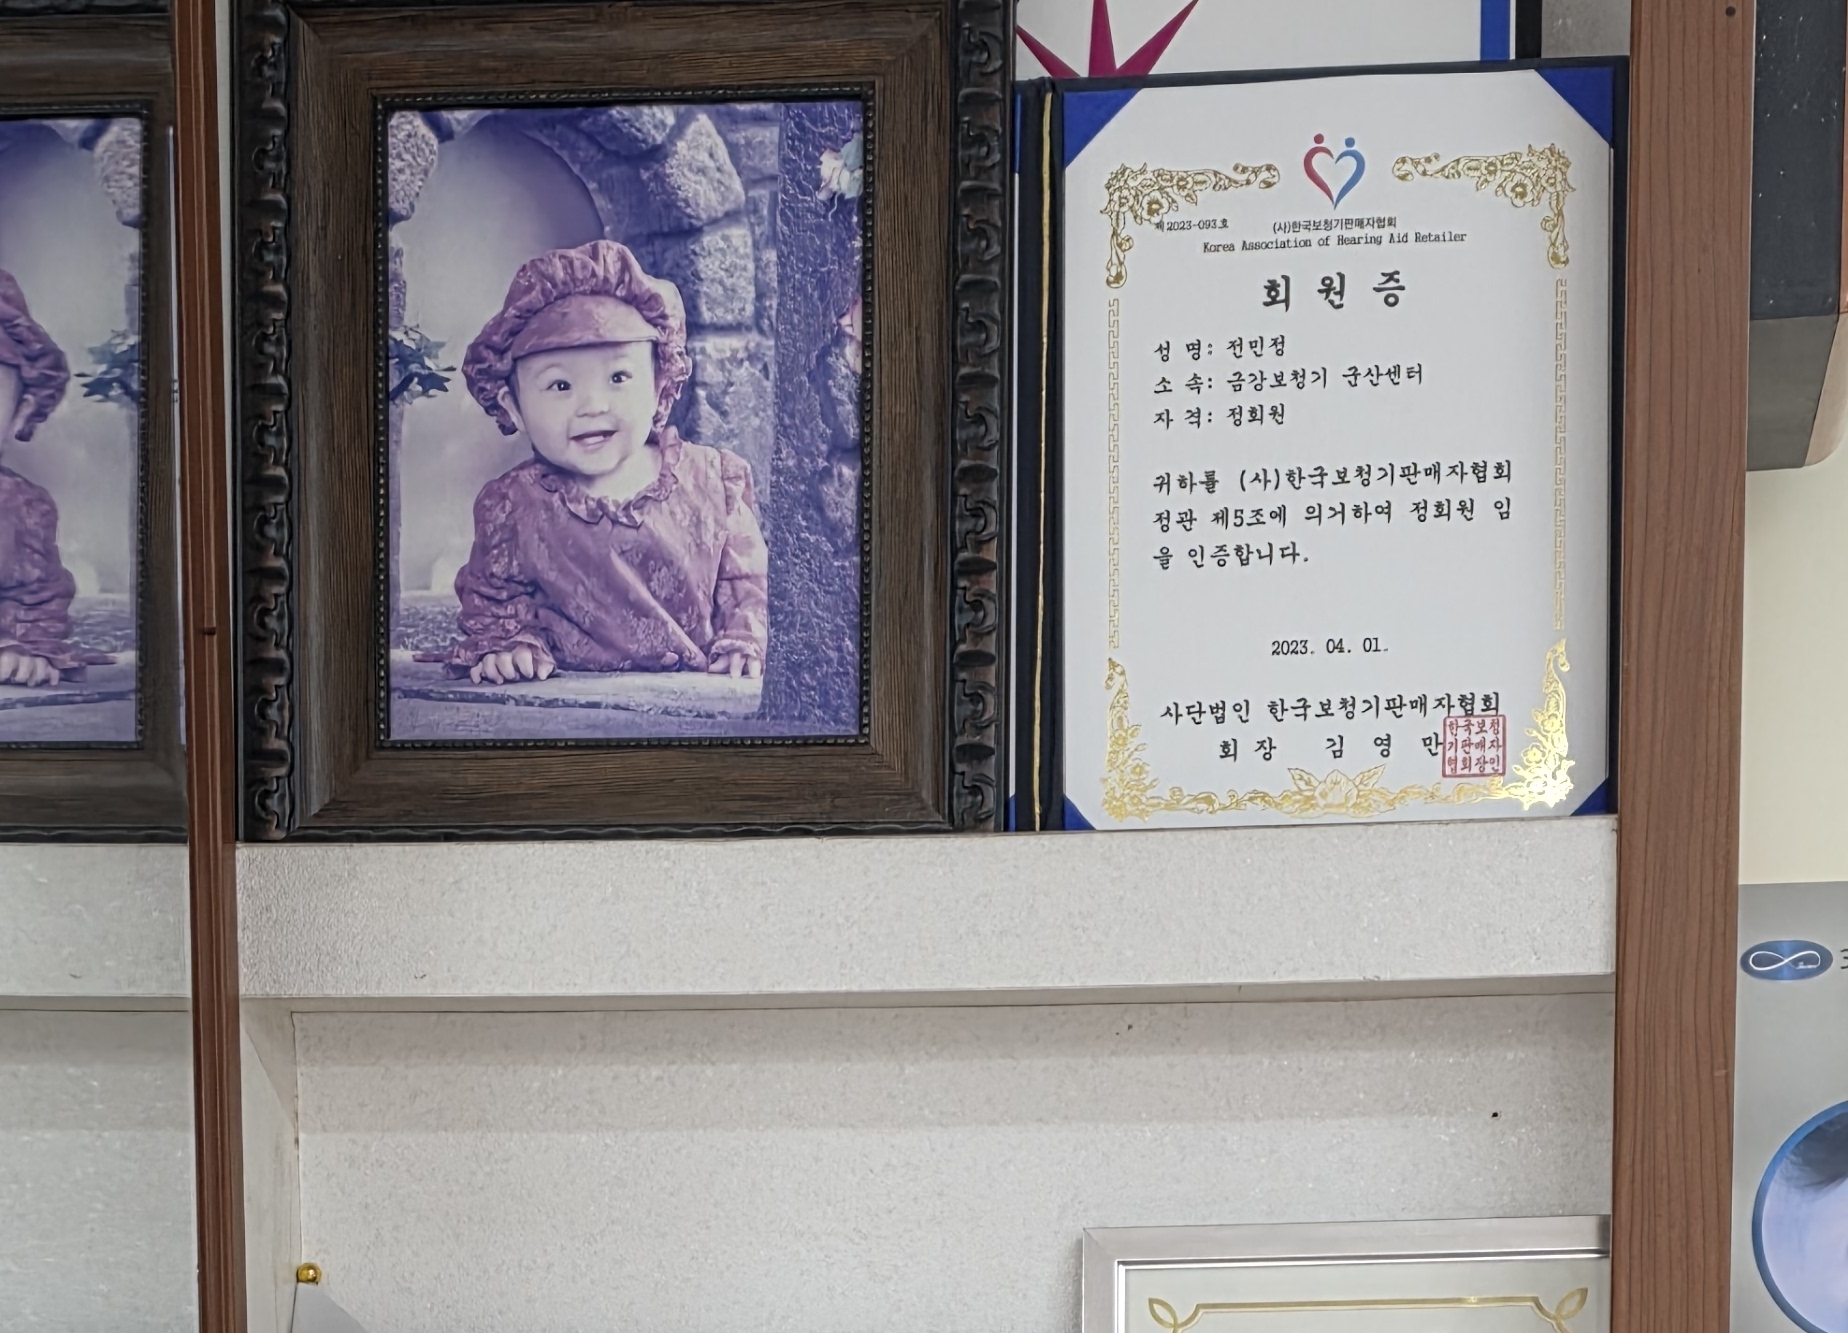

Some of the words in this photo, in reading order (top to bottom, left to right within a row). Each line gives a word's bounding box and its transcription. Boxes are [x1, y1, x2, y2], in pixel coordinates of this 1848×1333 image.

[1273, 217, 1396, 234] (사)한국보청기판매자협회
[1203, 242, 1235, 253] Korea
[1242, 238, 1312, 251] Association
[1317, 235, 1330, 246] of
[1337, 233, 1382, 245] Hearing
[1389, 232, 1408, 243] Aid
[1415, 231, 1467, 242] Retailer
[1227, 335, 1285, 359] 전민정
[1227, 367, 1326, 392] 금강보청기
[1342, 363, 1422, 387] 군산센터
[1227, 403, 1284, 427] 정회원
[1153, 470, 1219, 495] 귀하를
[1240, 460, 1510, 492] (사)한국보청기판매자협회
[1153, 509, 1197, 533] 정관
[1211, 507, 1286, 530] 제5조에
[1305, 503, 1391, 526] 의거하여
[1410, 498, 1474, 522] 정회원
[1188, 541, 1308, 568] 인증합니다.
[1326, 638, 1351, 654] 04.
[1161, 699, 1249, 725] 사단법인
[1267, 692, 1499, 721] 한국보청기판매자협회
